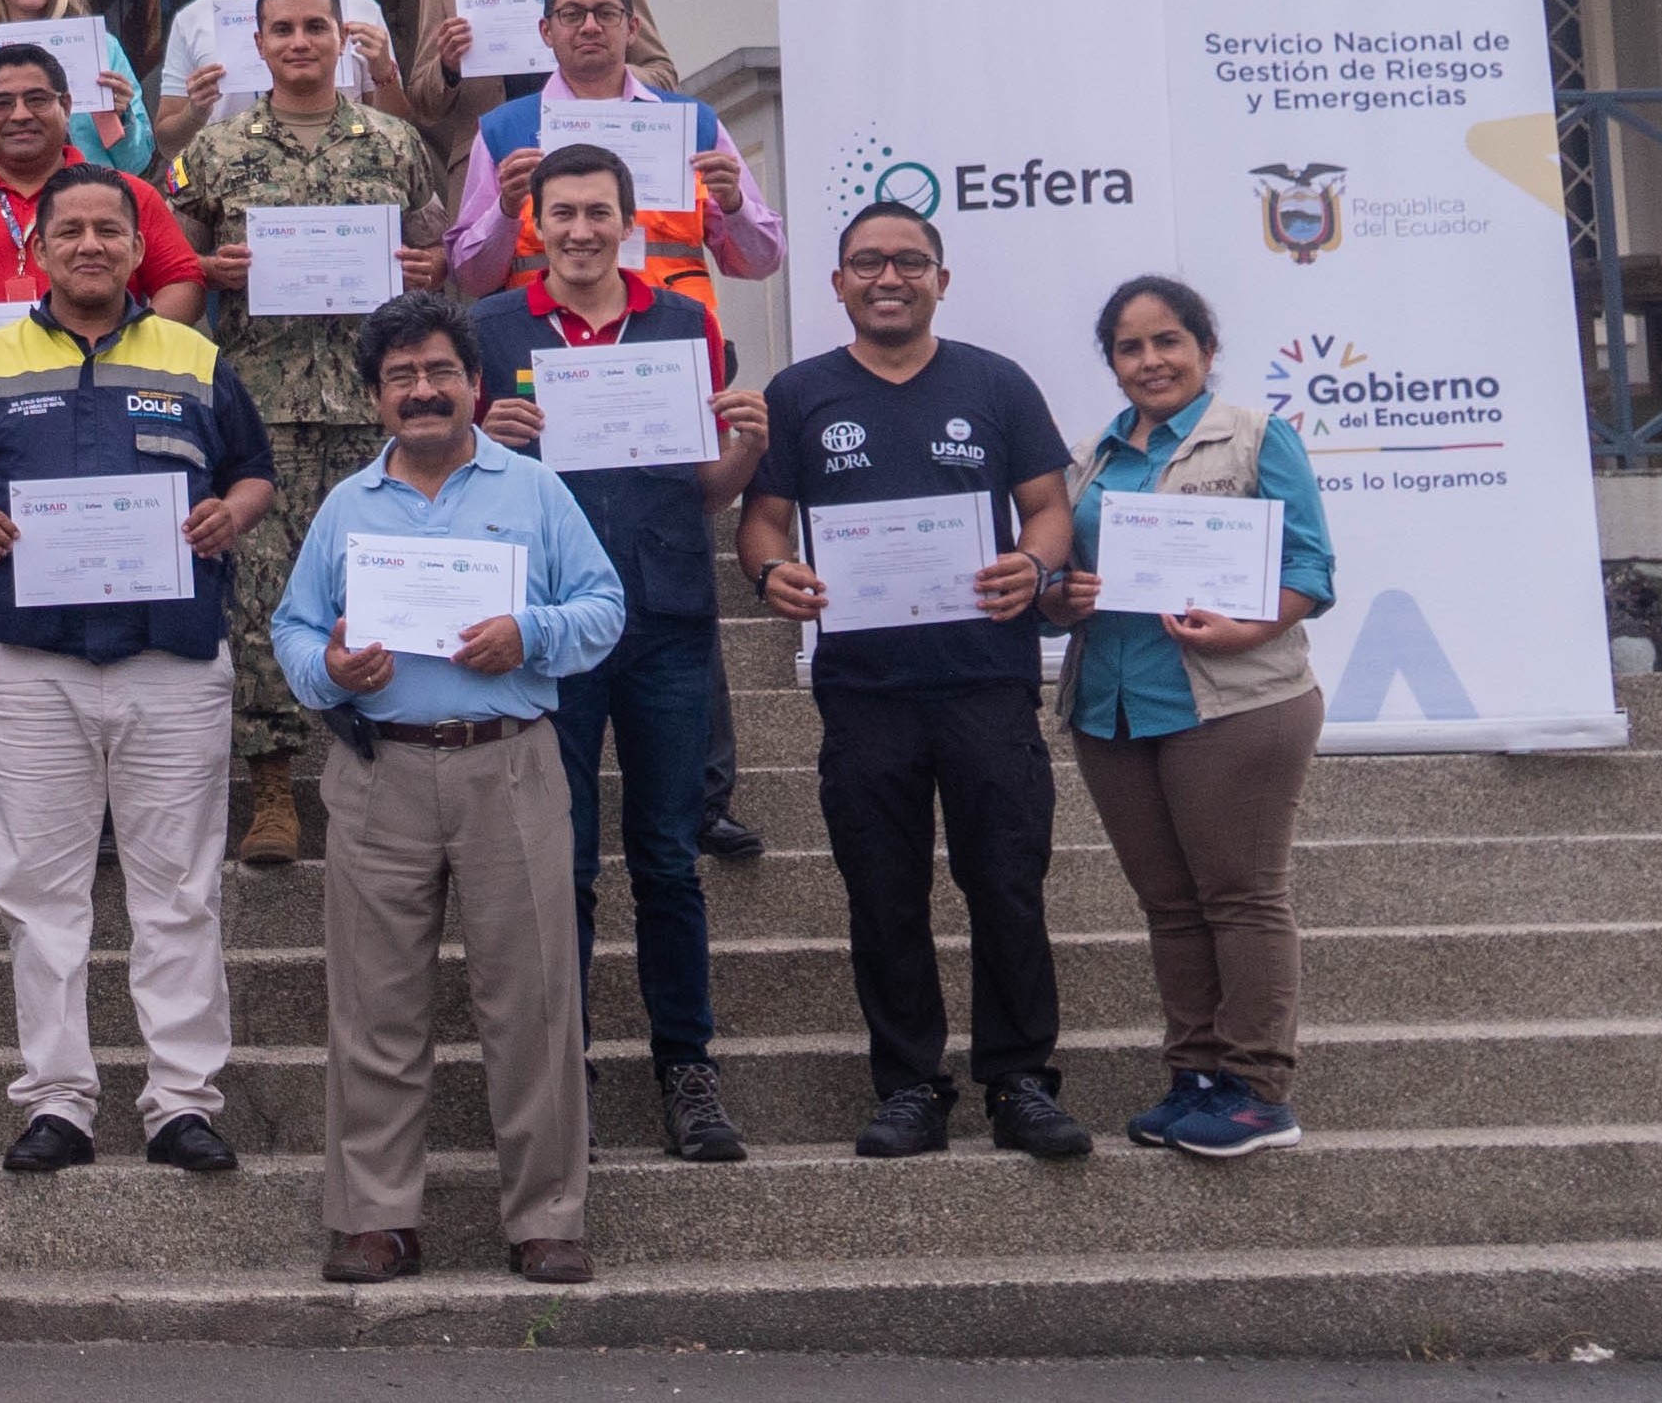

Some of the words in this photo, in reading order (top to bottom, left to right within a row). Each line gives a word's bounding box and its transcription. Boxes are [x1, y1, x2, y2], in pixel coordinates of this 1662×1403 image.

[1205, 33, 1323, 55] Servicio
[1334, 31, 1462, 54] Nacional
[1473, 30, 1510, 52] de
[1216, 60, 1328, 83] Gestión
[1340, 59, 1375, 80] de
[1386, 58, 1503, 84] Riesgos
[1246, 92, 1262, 114] y
[1275, 85, 1467, 112] Emergencias
[955, 158, 1133, 212] Esfera
[1352, 198, 1465, 221] República
[1354, 216, 1387, 238] del
[1395, 216, 1491, 237] Ecuador
[1307, 372, 1500, 406] Gobierno
[127, 394, 183, 415] Daule
[1339, 413, 1368, 429] del
[1375, 406, 1503, 427] Encuentro
[931, 442, 985, 460] USAID
[824, 453, 873, 475] ADRA
[1200, 478, 1236, 492] ADRA
[1318, 473, 1353, 492] tos
[1363, 472, 1384, 492] lo
[1393, 468, 1508, 494] logramos
[35, 502, 68, 512] USAID
[836, 526, 870, 537] USAID
[371, 556, 405, 567] USAID
